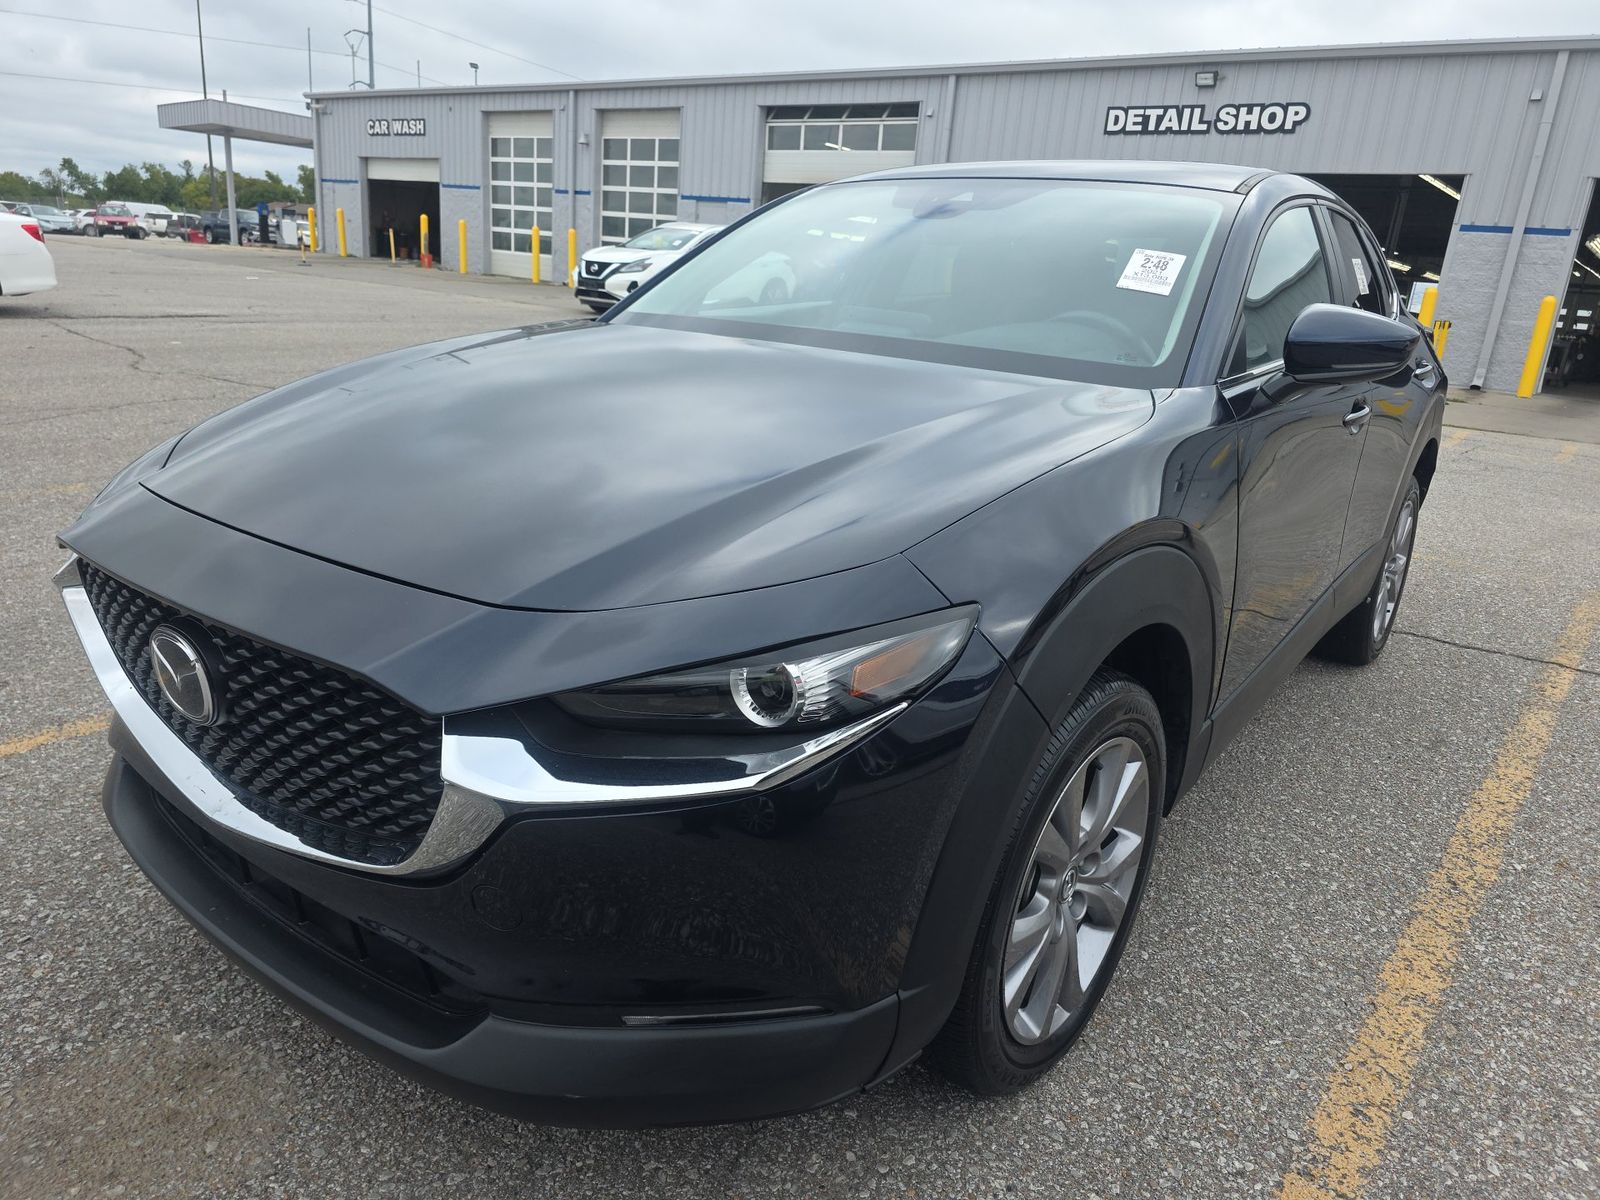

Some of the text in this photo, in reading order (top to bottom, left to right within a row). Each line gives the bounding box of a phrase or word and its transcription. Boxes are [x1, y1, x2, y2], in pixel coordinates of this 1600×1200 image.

[1106, 105, 1308, 132] DETAIL SHOP
[367, 120, 424, 135] CAR WASH
[1141, 257, 1169, 271] 2:48
